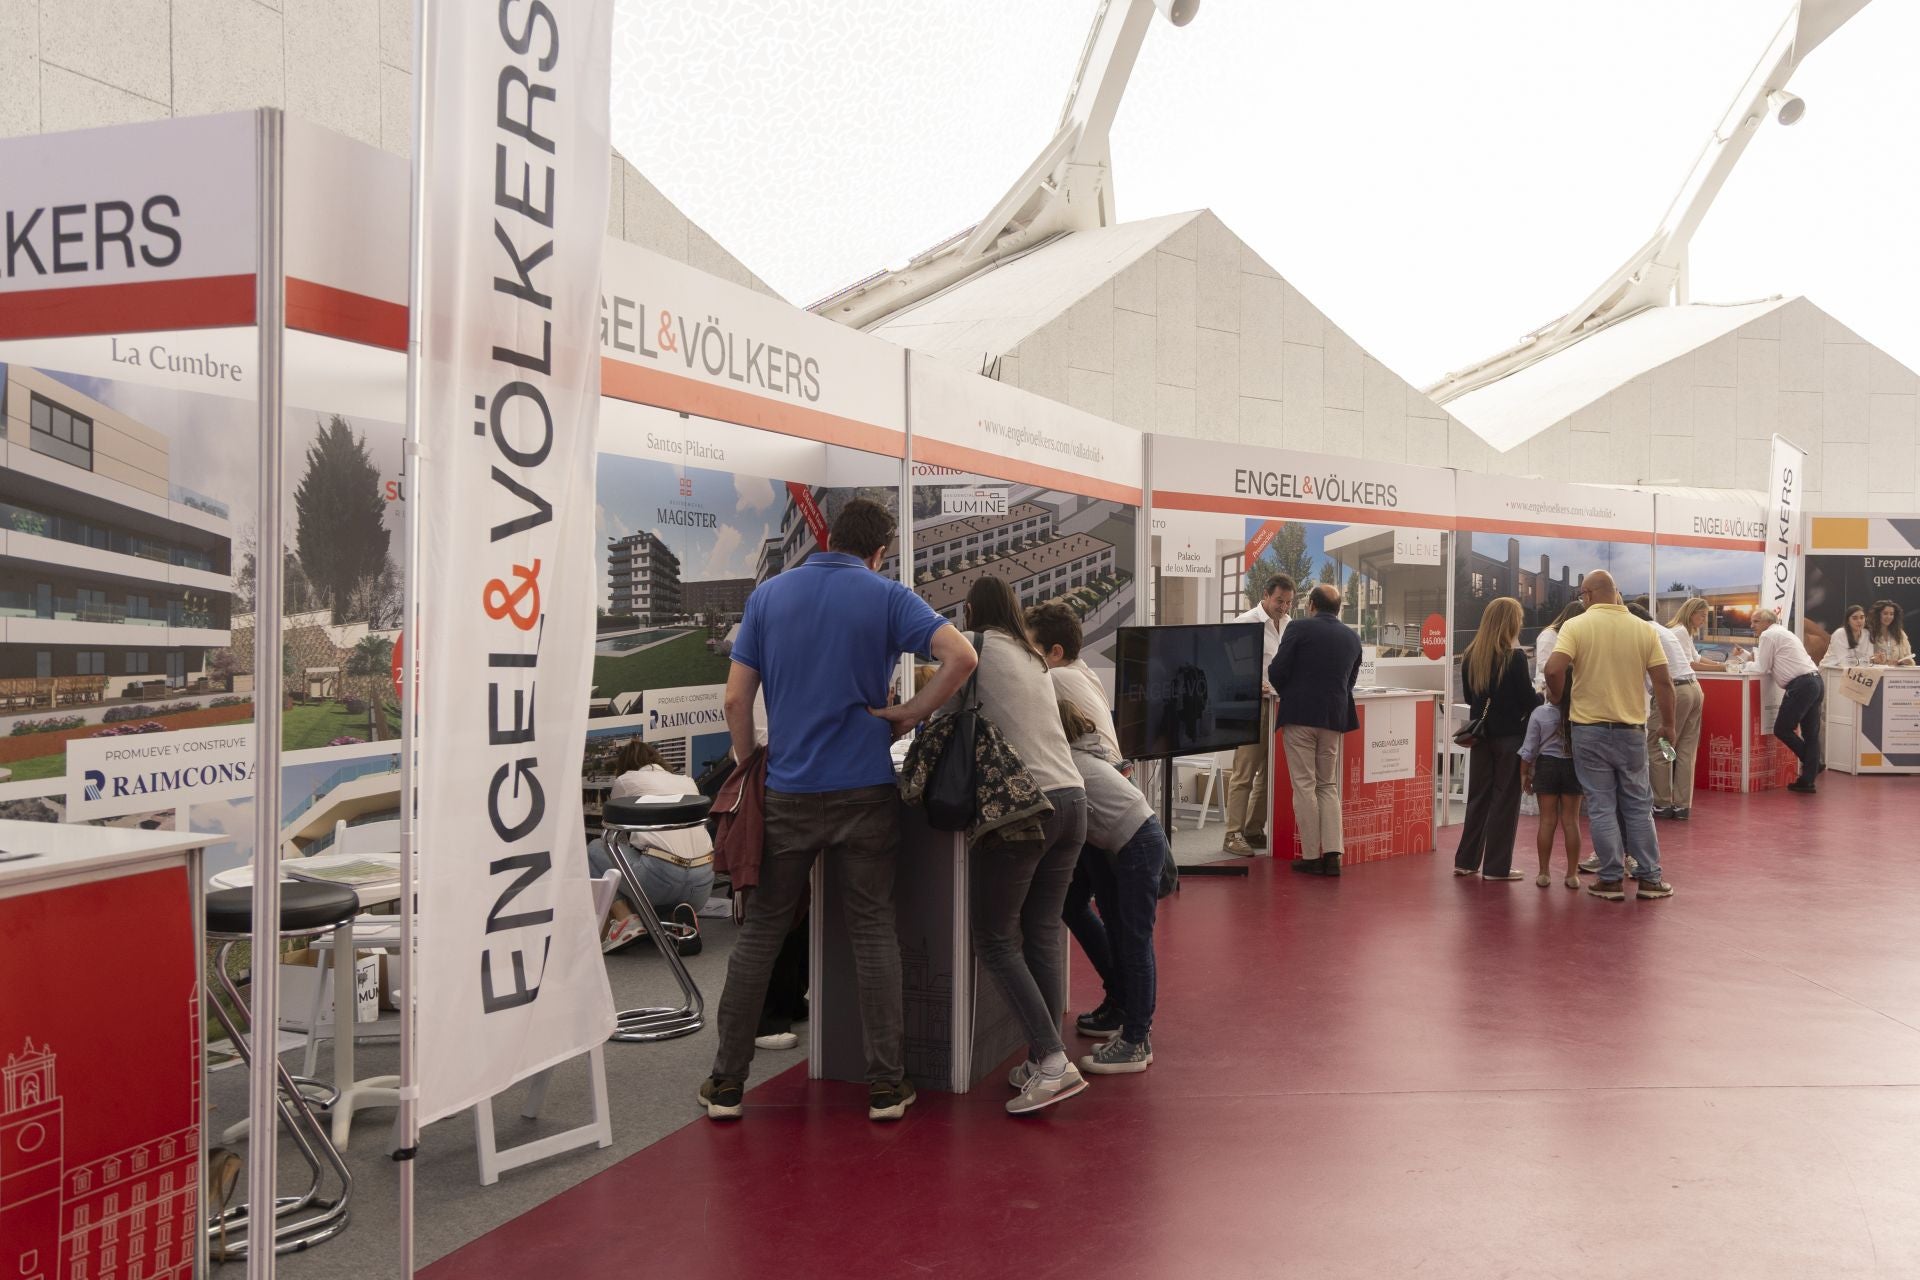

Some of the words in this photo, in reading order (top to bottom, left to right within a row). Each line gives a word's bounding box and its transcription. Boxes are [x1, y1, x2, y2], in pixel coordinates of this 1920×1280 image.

[0, 195, 182, 278] KERS
[111, 337, 141, 366] La
[149, 345, 243, 382] Cumbre
[647, 432, 682, 454] Santos
[686, 439, 725, 462] Pilarica
[1235, 468, 1398, 508] ENGEL&VÖLKERS
[943, 500, 1007, 514] LUMINE
[657, 507, 717, 530] MAGISTER
[1177, 551, 1201, 561] Palacio
[1396, 542, 1439, 557] SILENE
[1165, 564, 1174, 573] de
[1174, 564, 1184, 573] los
[1186, 564, 1212, 574] Miranda
[1863, 556, 1875, 568] El
[1873, 575, 1895, 587] que
[105, 745, 171, 761] PROMUEVE
[174, 743, 182, 754] Y
[182, 737, 247, 753] CONSTRUYE
